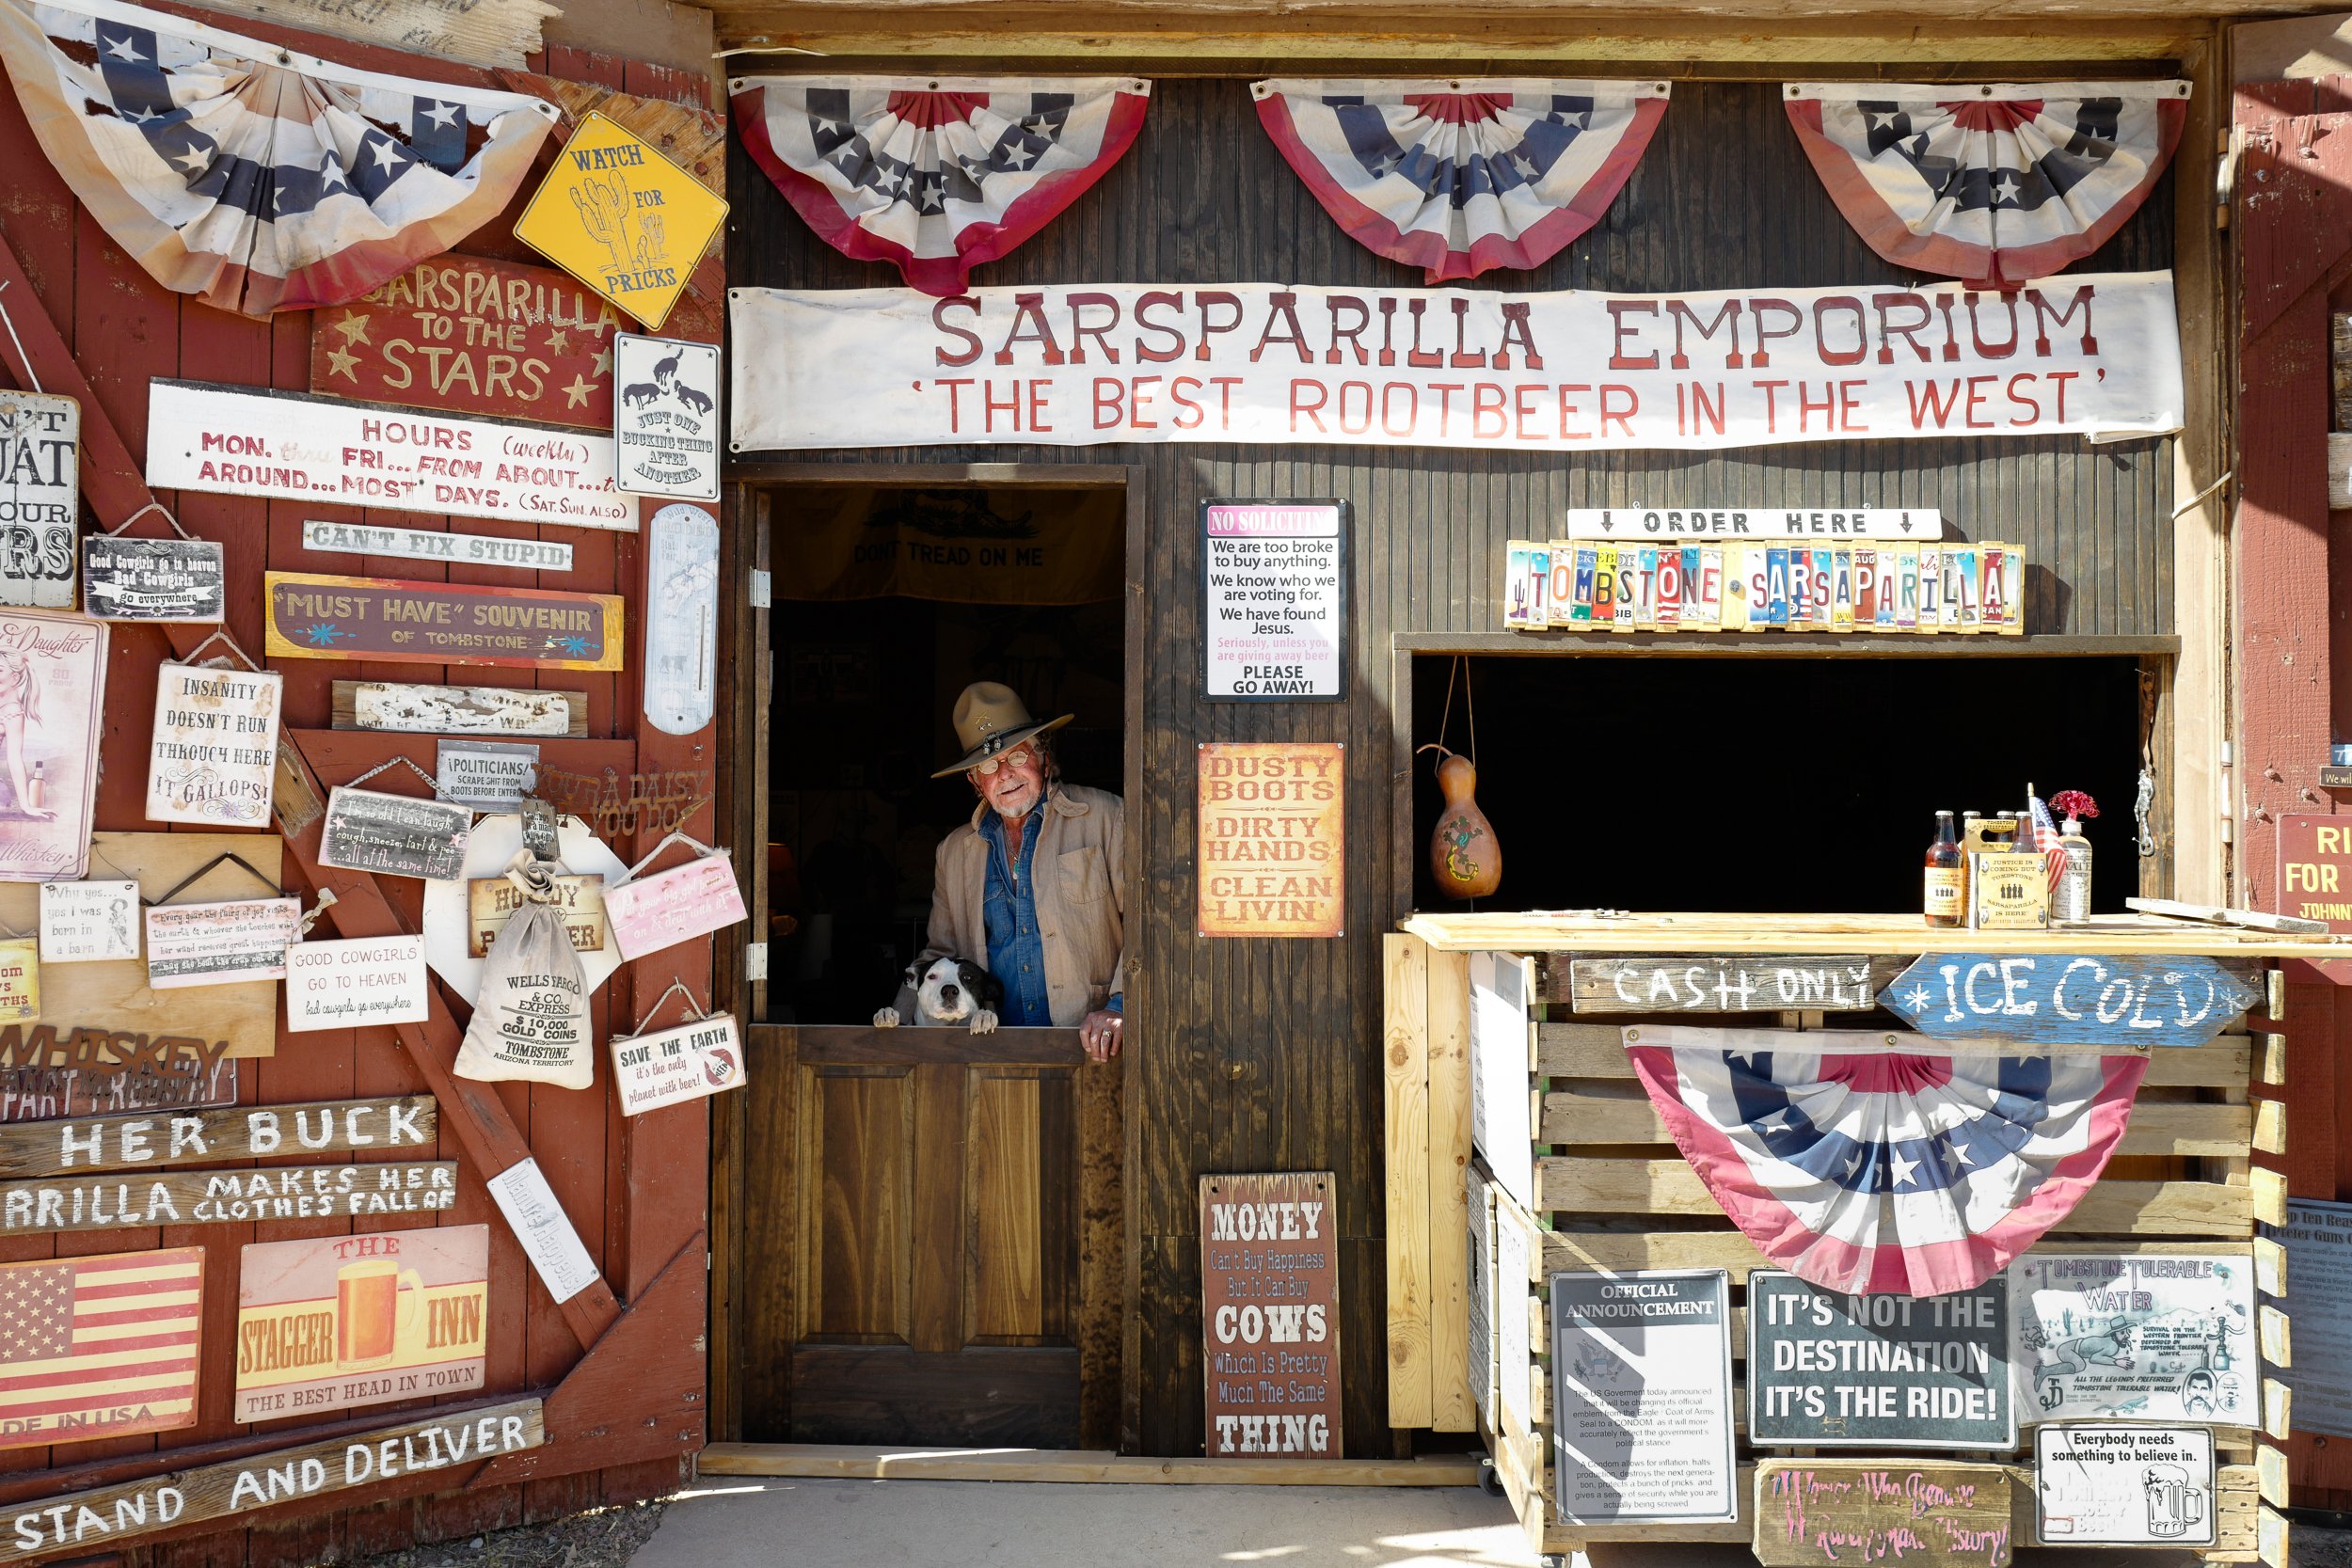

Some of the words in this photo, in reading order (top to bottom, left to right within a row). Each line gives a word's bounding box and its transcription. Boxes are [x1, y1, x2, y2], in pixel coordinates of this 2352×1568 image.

[570, 144, 644, 171] WATCH
[634, 190, 665, 208] FOR
[606, 267, 676, 293] PRICKS
[413, 312, 453, 341] TO
[459, 317, 526, 352] THE
[934, 291, 1544, 370] SARSPARILLA
[1606, 285, 2098, 370] EMPORIUM
[382, 340, 550, 400] STARS
[1094, 376, 1244, 430] BEST
[1291, 378, 1639, 439] ROOTBEER
[1677, 381, 1725, 436] IN
[1753, 379, 1868, 435] THE
[637, 412, 672, 429] JUST
[674, 414, 701, 435] ONE
[201, 432, 272, 458] MON.
[362, 420, 472, 451] HOURS
[622, 432, 675, 449] BUCKING
[677, 438, 713, 452] THING
[648, 451, 688, 466] AFTER
[634, 463, 701, 484] ANOTHER
[437, 484, 508, 509] DAYS.
[1211, 512, 1234, 531] NO
[1645, 513, 1750, 533] ORDER
[1787, 513, 1867, 533] HERE
[312, 525, 395, 549] CAN'T
[409, 535, 455, 557] FIX
[469, 540, 565, 565] STUPID
[907, 542, 970, 564] TREAD
[979, 547, 1006, 565] ON
[1016, 547, 1042, 565] ME
[1213, 541, 1234, 552] We
[1239, 544, 1261, 552] are
[1264, 542, 1288, 553] too
[1293, 540, 1332, 553] broke
[90, 554, 110, 569] Good
[117, 555, 153, 571] Cowgirls
[187, 558, 215, 572] heaven
[1215, 557, 1230, 567] to
[1234, 555, 1261, 569] buy
[1264, 555, 1331, 569] anything.
[114, 571, 135, 584] Bad
[143, 572, 194, 588] Cowgirls
[1211, 575, 1232, 586] We
[1237, 574, 1276, 586] know
[1279, 574, 1311, 586] who
[1315, 578, 1335, 587] we
[1532, 566, 1719, 608] TOMBSTONE
[1753, 563, 2002, 611] SARSAPARILLA
[119, 594, 134, 607] go
[139, 593, 197, 605] everywhere
[1224, 591, 1246, 601] are
[1250, 589, 1295, 603] voting
[1299, 588, 1322, 601] for.
[474, 605, 592, 632] SOUVENIR
[18, 626, 94, 658] Daughter
[391, 630, 414, 643] OF
[425, 631, 527, 649] TOMBSTONE
[1244, 666, 1303, 678] PLEASE
[183, 677, 256, 700] INSANITY
[1233, 681, 1257, 693] GO
[1263, 681, 1312, 693] AWAY!
[167, 710, 230, 730] DOESN'T
[236, 715, 267, 733] RUN
[233, 749, 272, 766] HERE
[1210, 757, 1334, 777] DUSTY
[451, 785, 471, 796] BOOTS
[473, 786, 495, 797] BEFORE
[458, 775, 485, 784] SCRAPE
[502, 778, 521, 786] FROM
[1210, 781, 1334, 800] BOOTS
[183, 780, 268, 805] GALLOPS!
[1216, 817, 1321, 837] DIRTY
[1206, 841, 1330, 861] HANDS
[1211, 877, 1333, 897] CLEAN
[2285, 863, 2340, 893] FOR
[1216, 900, 1325, 921] LIVIN'
[295, 953, 332, 967] GOOD
[342, 948, 417, 964] COWGIRLS
[309, 978, 326, 990] GO
[336, 976, 351, 989] TO
[359, 973, 406, 987] HEAVEN
[507, 975, 548, 990] WELLS
[551, 976, 580, 995] FARGO
[1613, 967, 1756, 1010] CASH
[1778, 961, 1870, 1010] ONLY
[1939, 958, 2037, 1023] ICE
[2052, 958, 2213, 1028] COLD
[306, 1000, 320, 1015] bad
[519, 1001, 569, 1014] EXPRESS
[503, 1023, 535, 1037] GOLD
[544, 1030, 577, 1039] COINS
[531, 1020, 567, 1030] 10,000
[505, 1041, 570, 1059] TOMBSTONE
[621, 1046, 651, 1068] SAVE
[660, 1038, 681, 1057] THE
[691, 1027, 727, 1050] EARTH
[494, 1053, 530, 1065] ARIZONA
[532, 1058, 574, 1067] TERRITORY
[668, 1057, 687, 1076] only
[628, 1085, 657, 1106] planet
[60, 1116, 208, 1167] HER
[248, 1105, 426, 1153] BUCK
[207, 1167, 358, 1197] MAKES
[379, 1168, 452, 1190] HER
[193, 1196, 334, 1222] CLOTHES
[350, 1191, 418, 1214] FALL
[1211, 1202, 1323, 1242] MONEY
[333, 1236, 401, 1259] THE
[1211, 1249, 1239, 1270] Can't
[1244, 1249, 1263, 1274] Buy
[1267, 1249, 1325, 1272] Happiness
[2038, 1259, 2126, 1289] TOMBSTONE
[2128, 1260, 2213, 1289] TOLERABLE
[1600, 1284, 1677, 1299] OFFICIAL
[2077, 1281, 2152, 1311] WATER
[1565, 1301, 1714, 1318] ANNOUNCEMENT
[1768, 1293, 1833, 1326] IT'S
[1848, 1295, 1916, 1327] NOT
[1930, 1296, 1994, 1328] THE
[240, 1311, 334, 1374] STAGGER
[426, 1293, 481, 1349] INN
[1215, 1304, 1327, 1344] COWS
[1215, 1353, 1256, 1374] Which
[1279, 1351, 1327, 1375] Pretty
[1773, 1340, 1989, 1373] DESTINATION
[247, 1393, 285, 1413] THE
[293, 1387, 335, 1407] BEST
[343, 1380, 392, 1400] HEAD
[399, 1374, 419, 1392] IN
[425, 1366, 477, 1388] TOWN
[1766, 1386, 1826, 1417] IT'S
[1834, 1386, 1897, 1418] THE
[1907, 1387, 1996, 1420] RIDE!
[95, 1404, 154, 1426] USA
[1216, 1414, 1328, 1453] THING
[2074, 1433, 2135, 1449] Everybody
[2139, 1433, 2174, 1445] needs
[2052, 1450, 2114, 1464] something
[2119, 1451, 2131, 1462] to
[2135, 1450, 2178, 1462] believe
[2183, 1451, 2197, 1462] in.
[14, 1487, 183, 1551] STAND
[230, 1457, 325, 1510] AND
[345, 1416, 528, 1485] DELIVER
